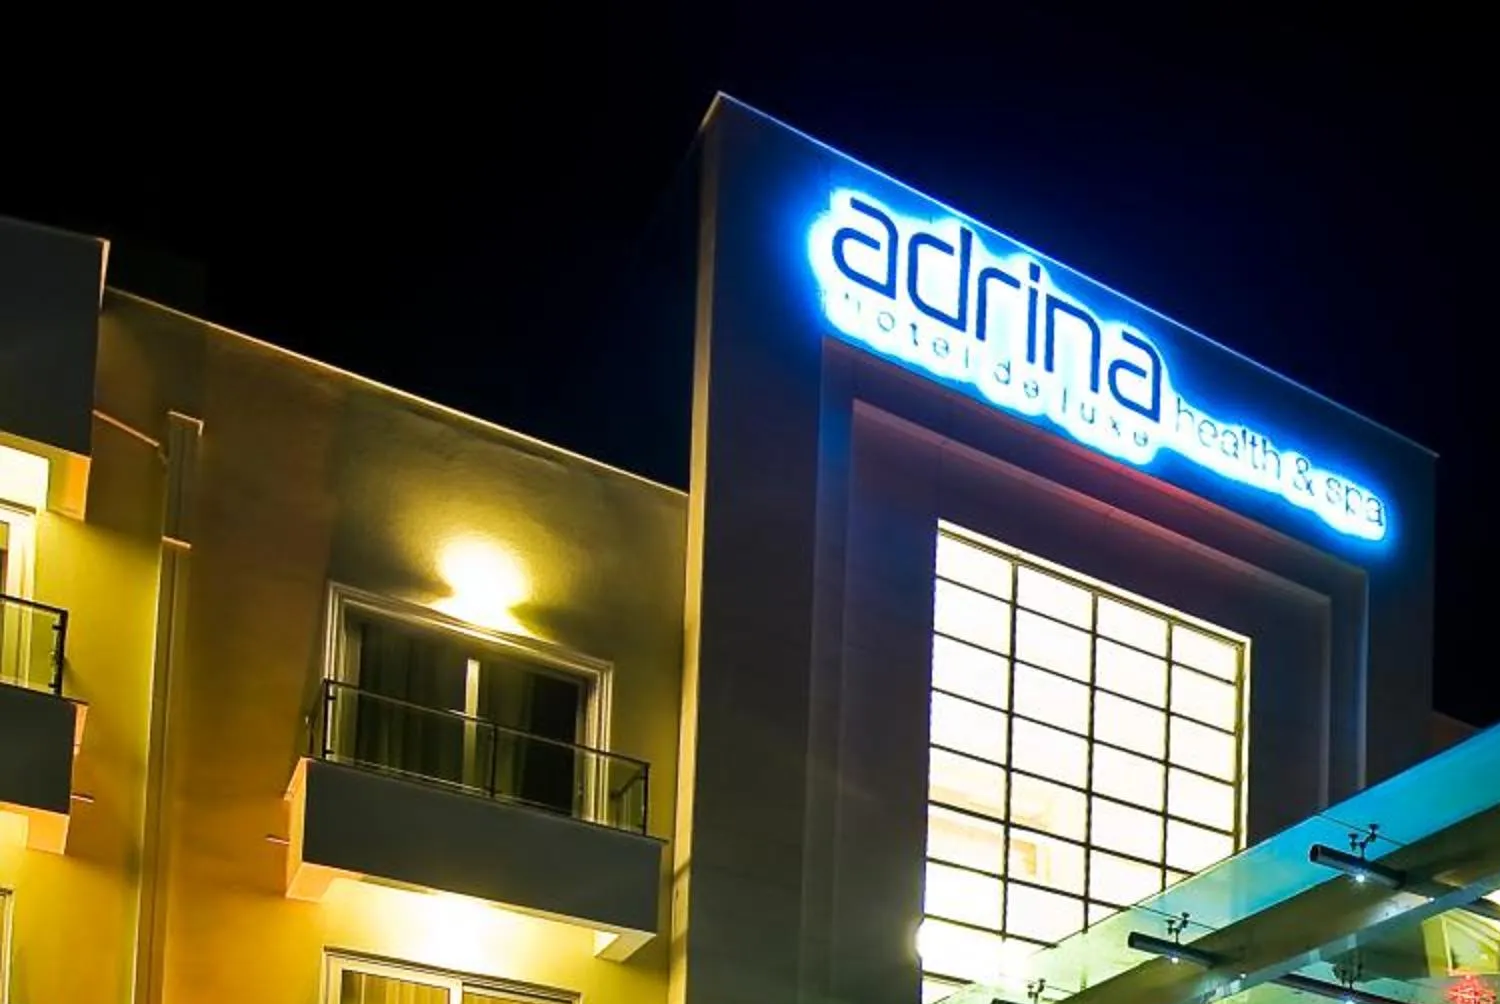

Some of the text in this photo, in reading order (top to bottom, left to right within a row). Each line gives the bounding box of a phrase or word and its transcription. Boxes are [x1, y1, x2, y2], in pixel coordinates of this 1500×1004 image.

[832, 197, 1162, 423] adrina
[1176, 397, 1384, 527] health & spa
